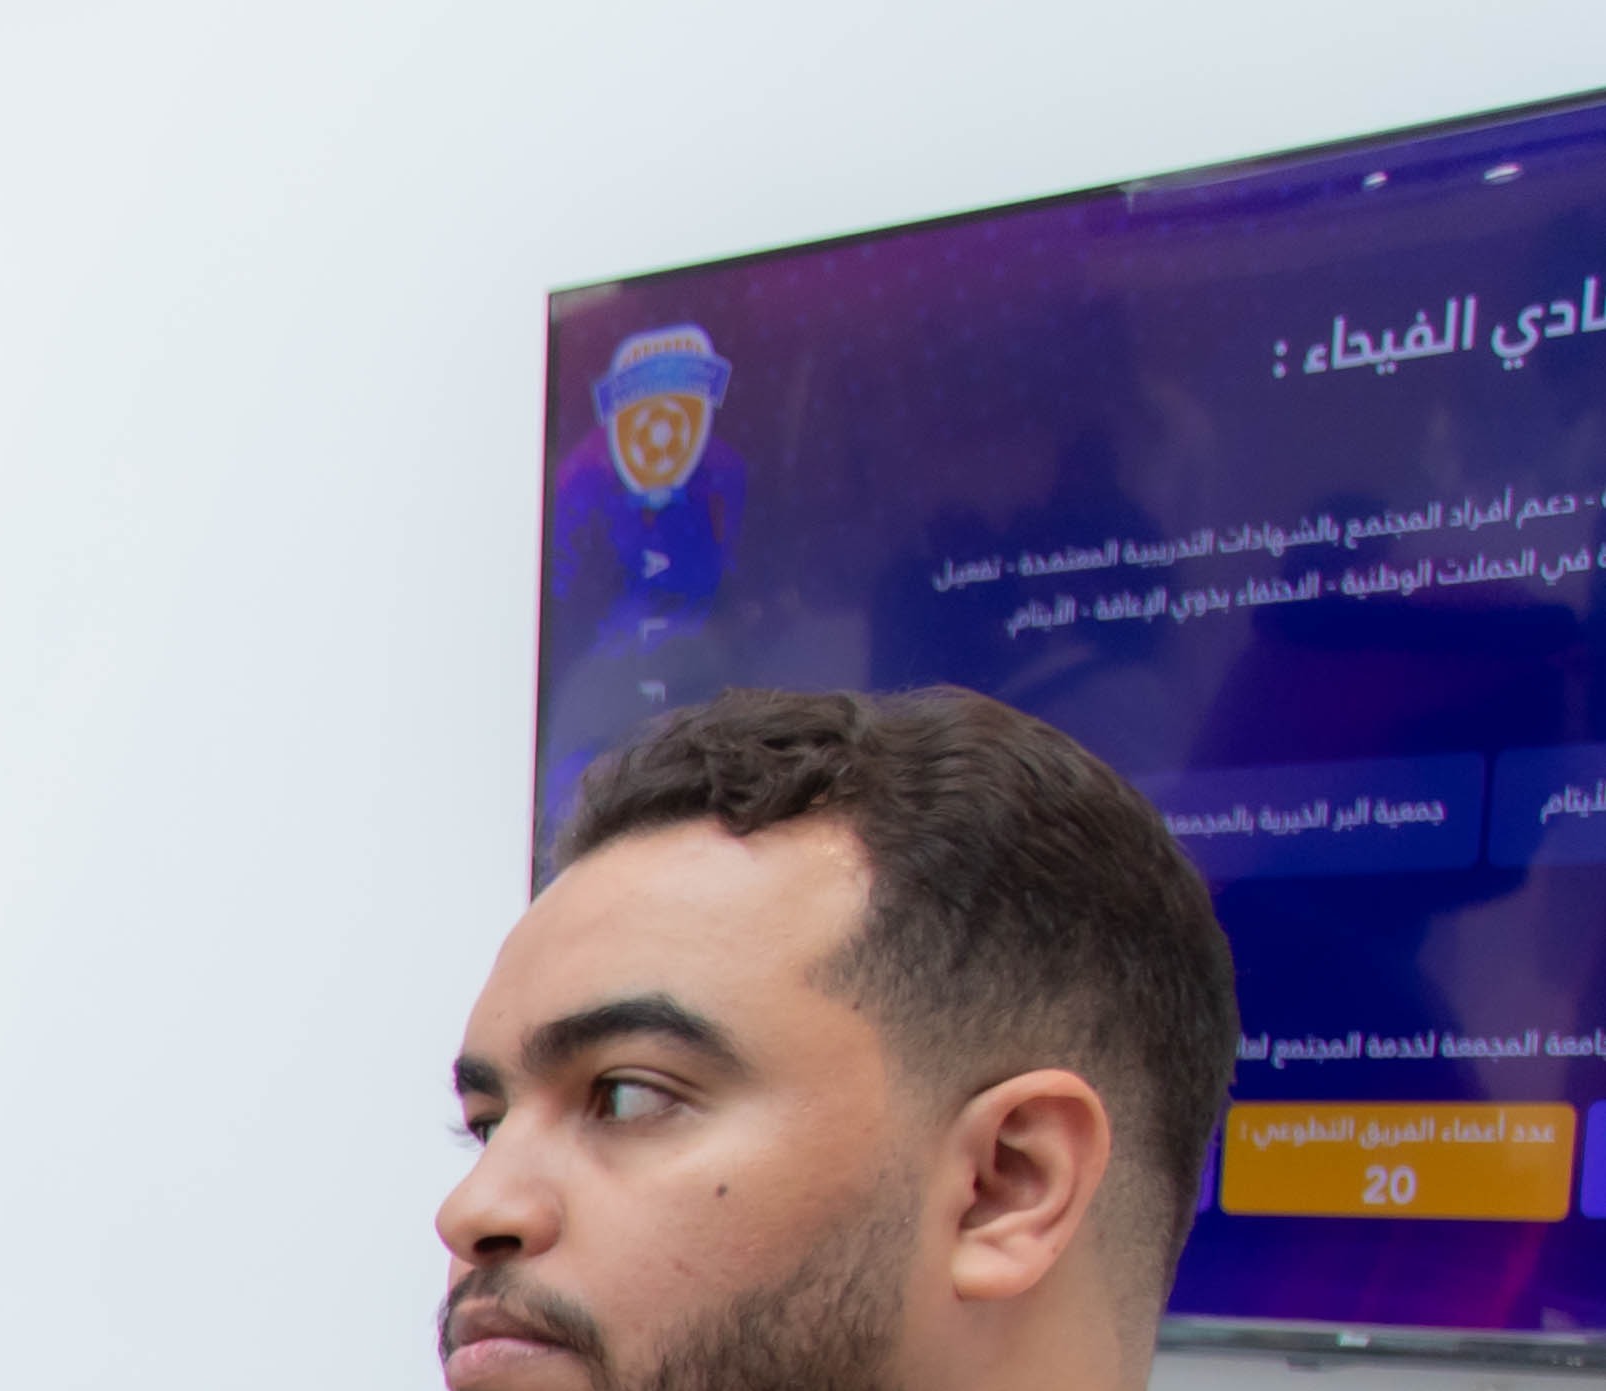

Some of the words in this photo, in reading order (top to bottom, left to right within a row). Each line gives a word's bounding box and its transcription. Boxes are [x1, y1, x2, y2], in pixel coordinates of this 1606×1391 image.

[1302, 293, 1478, 377] الفيحاء
[1491, 274, 1606, 371] ادي
[1343, 500, 1443, 550] المجتمع
[1449, 483, 1512, 532] أفراد
[1516, 492, 1576, 530] دعم
[1219, 513, 1340, 557] بالشهادات
[1341, 558, 1432, 599] الوطنية
[1436, 547, 1536, 586] الحملات
[1540, 546, 1592, 586] في
[1331, 795, 1370, 833] البر
[1374, 798, 1447, 828] جمعية
[1235, 1031, 1270, 1061] لعا
[1270, 1030, 1363, 1070] المجتمع
[1365, 1028, 1437, 1059] لخدمة
[1441, 1027, 1539, 1064] المجمعة
[1545, 1026, 1606, 1062] امعة
[1251, 1115, 1356, 1152] التطوعي
[1359, 1115, 1436, 1150] الفريق
[1441, 1108, 1506, 1144] أعضاء
[1510, 1121, 1557, 1144] عدد
[1362, 1163, 1418, 1206] 20
